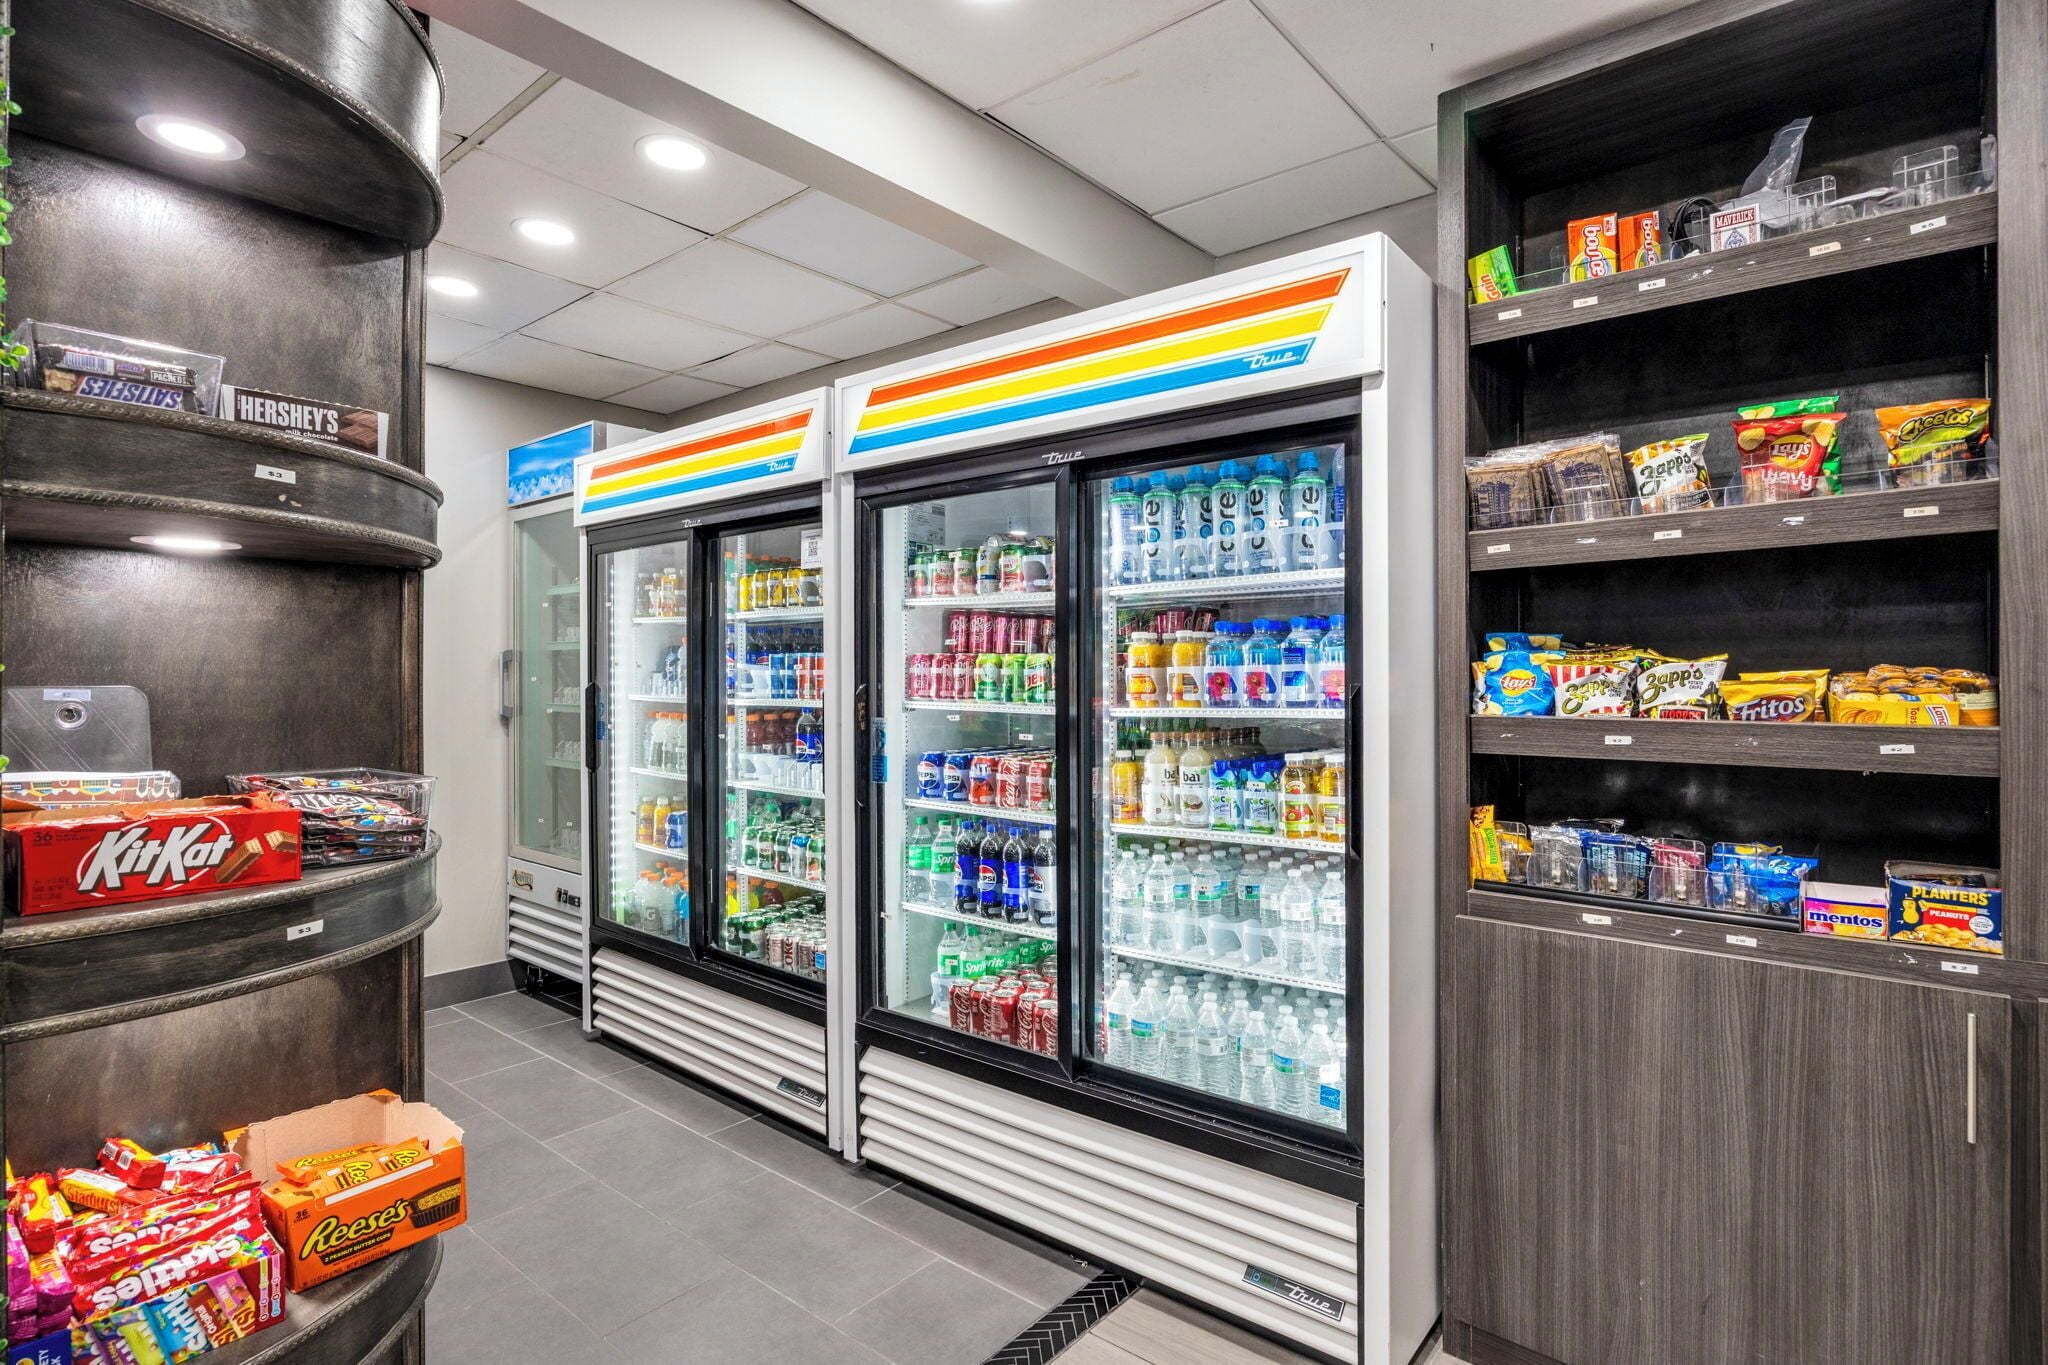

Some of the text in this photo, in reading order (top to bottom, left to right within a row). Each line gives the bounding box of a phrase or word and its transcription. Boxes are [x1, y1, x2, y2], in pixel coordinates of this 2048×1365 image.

[1715, 209, 1754, 228] MAVERICK
[1481, 274, 1502, 300] Gain
[79, 376, 183, 410] SATISFIES
[240, 394, 339, 434] HERSHEY'S
[1898, 408, 1975, 442] Cheetos
[303, 431, 339, 442] chocolate
[1220, 492, 1237, 553] core
[1249, 488, 1266, 550] core
[1731, 696, 1806, 720] Fritos
[1912, 885, 1989, 906] PLANTERS
[647, 908, 656, 920] G
[1809, 909, 1883, 928] mentos
[1929, 909, 1970, 921] PEANUTS
[296, 1208, 308, 1217] 36
[300, 1197, 409, 1261] Reese's
[329, 1248, 354, 1261] PEANUT
[353, 1240, 376, 1252] BUTTER
[376, 1232, 392, 1243] CUPS
[196, 1304, 215, 1334] Original
